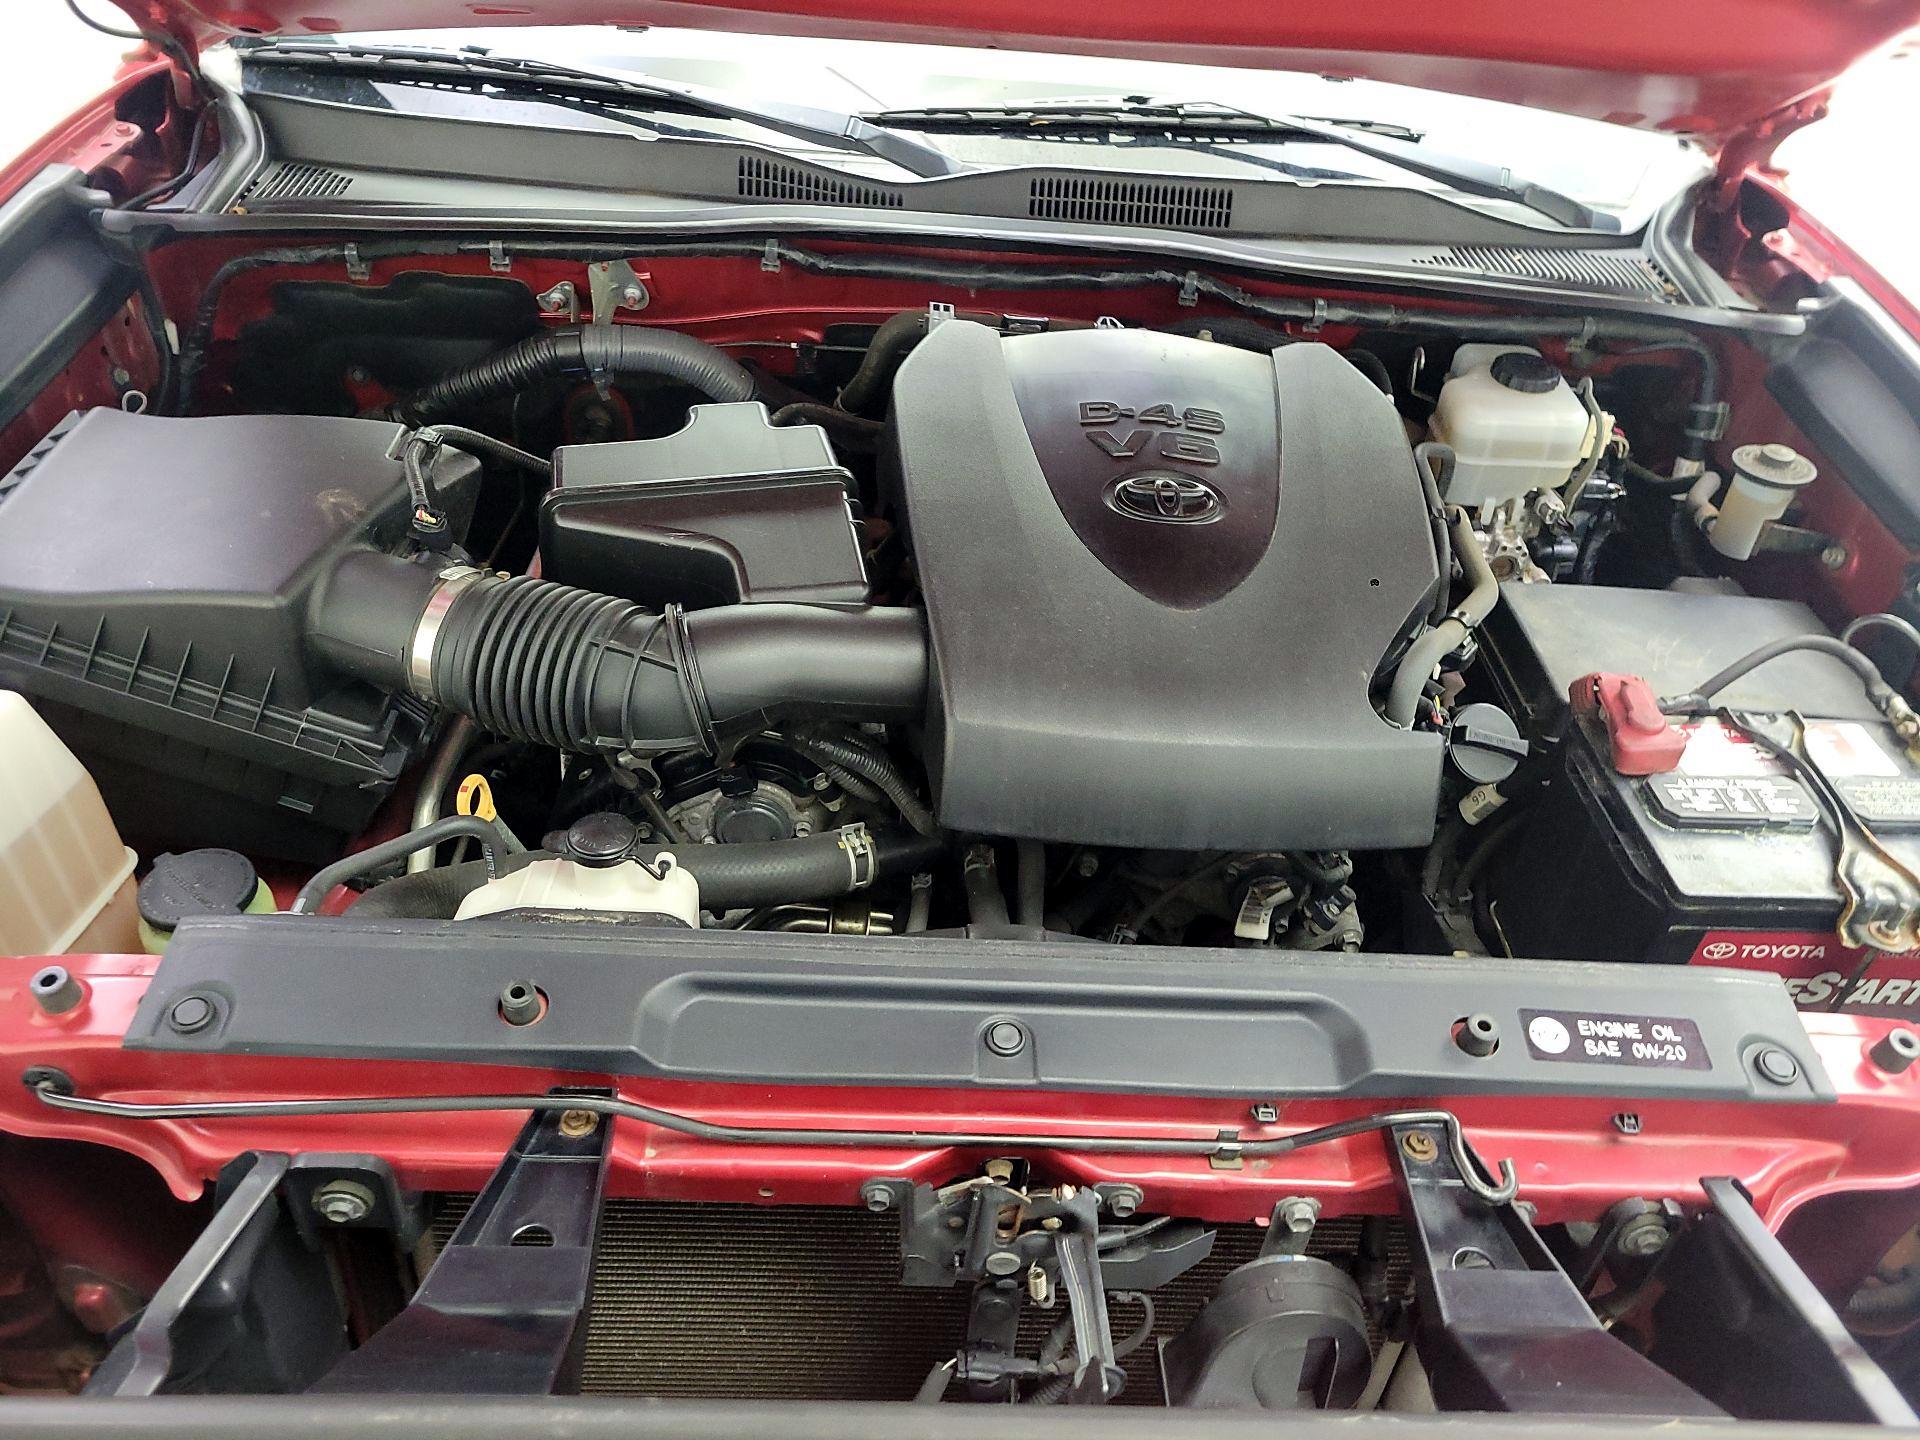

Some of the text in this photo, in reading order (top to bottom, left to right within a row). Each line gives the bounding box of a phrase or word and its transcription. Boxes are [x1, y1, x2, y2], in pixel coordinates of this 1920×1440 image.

[1079, 401, 1226, 433] D-4S
[1085, 430, 1221, 465] V6
[1740, 944, 1826, 959] TOYOTA
[1577, 1019, 1682, 1042] ENGINE OIL
[1584, 1039, 1687, 1061] SAE 0W-20
